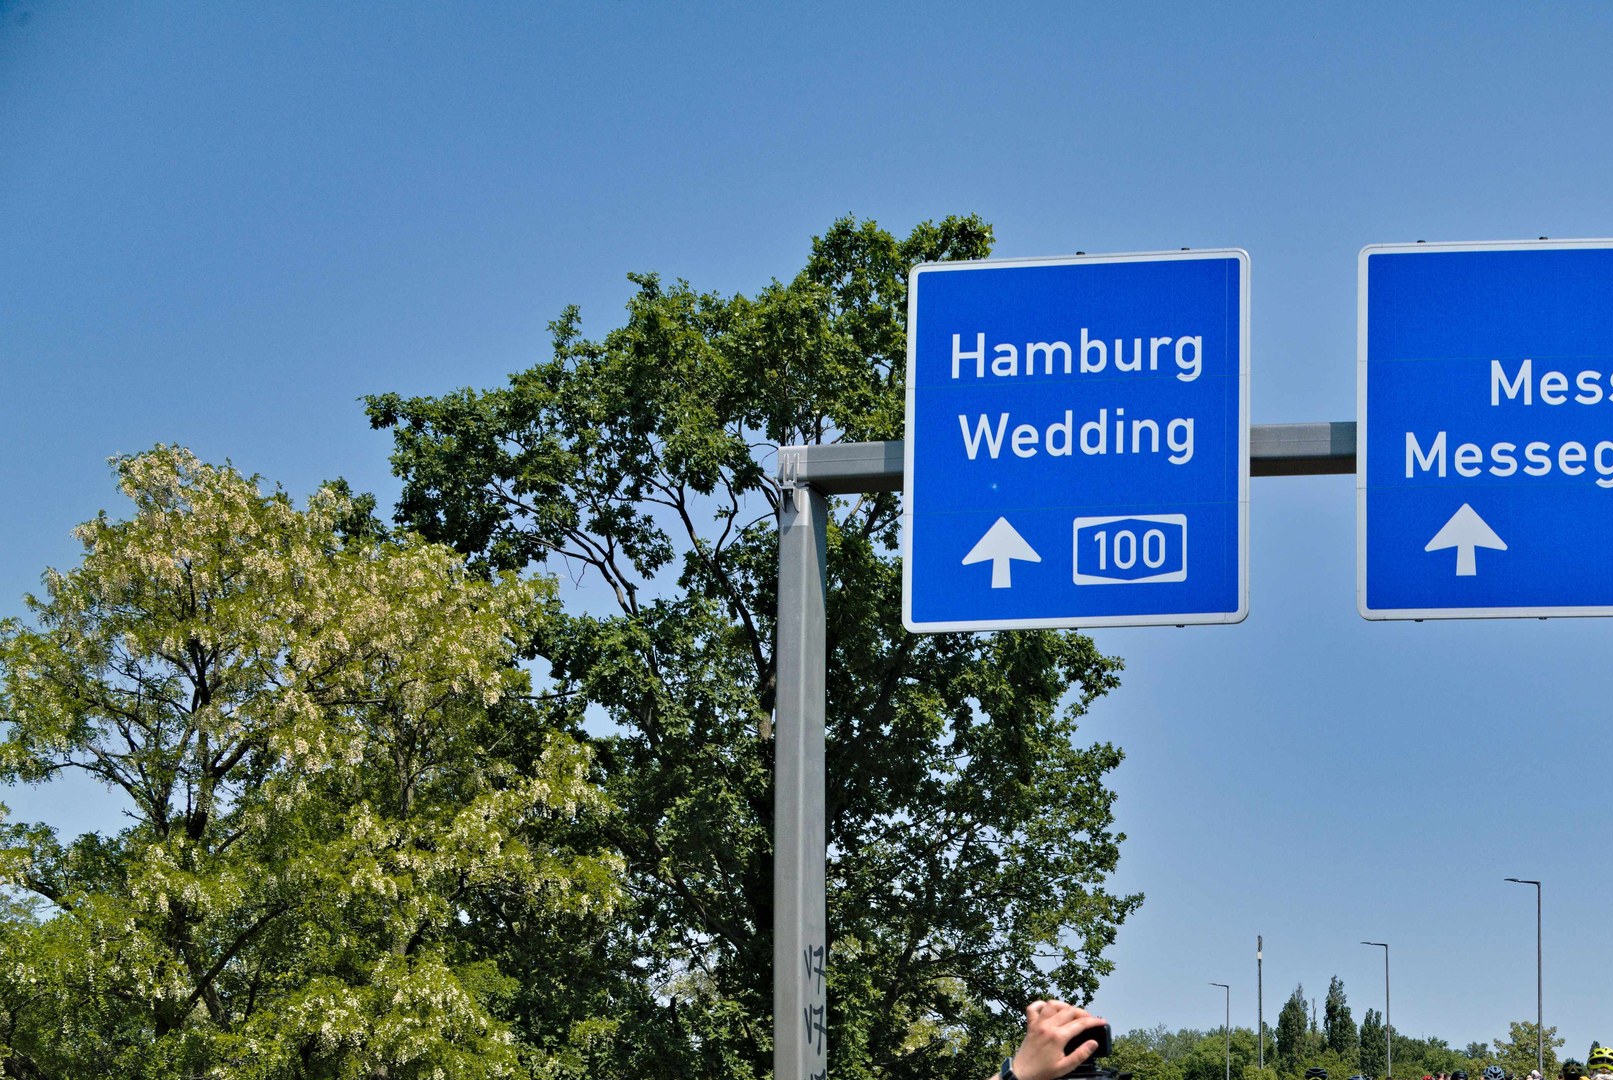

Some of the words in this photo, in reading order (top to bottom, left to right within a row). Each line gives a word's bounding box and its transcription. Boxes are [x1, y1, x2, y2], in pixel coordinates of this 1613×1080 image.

[951, 328, 1202, 382] Hamburg
[958, 408, 1194, 465] Wedding
[1093, 529, 1166, 570] 100
